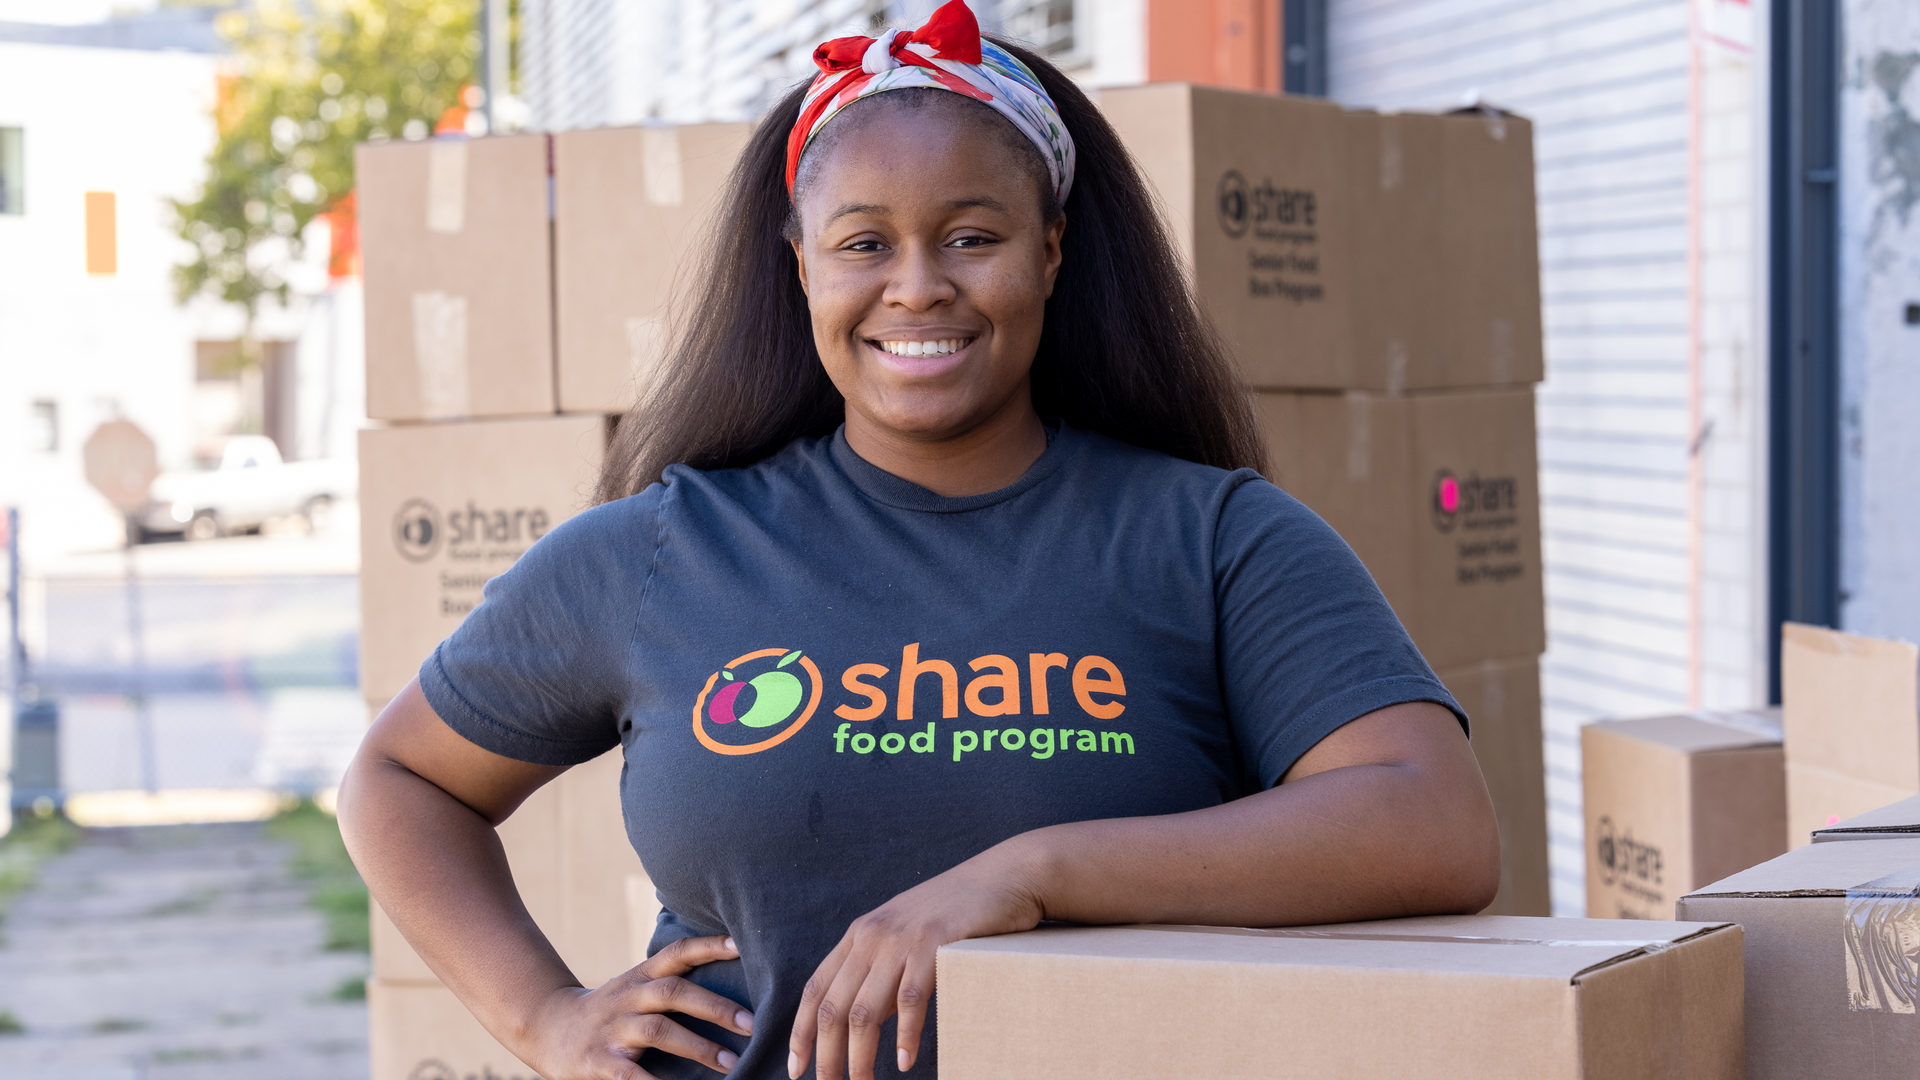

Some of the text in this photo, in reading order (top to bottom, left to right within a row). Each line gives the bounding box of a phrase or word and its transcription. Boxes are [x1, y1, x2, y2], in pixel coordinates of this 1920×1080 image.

[1253, 176, 1316, 227] share
[1275, 279, 1323, 304] Program
[1461, 472, 1516, 513] share
[448, 499, 549, 546] share
[833, 642, 1127, 721] share
[833, 722, 1136, 762] food program
[1618, 829, 1663, 884] share
